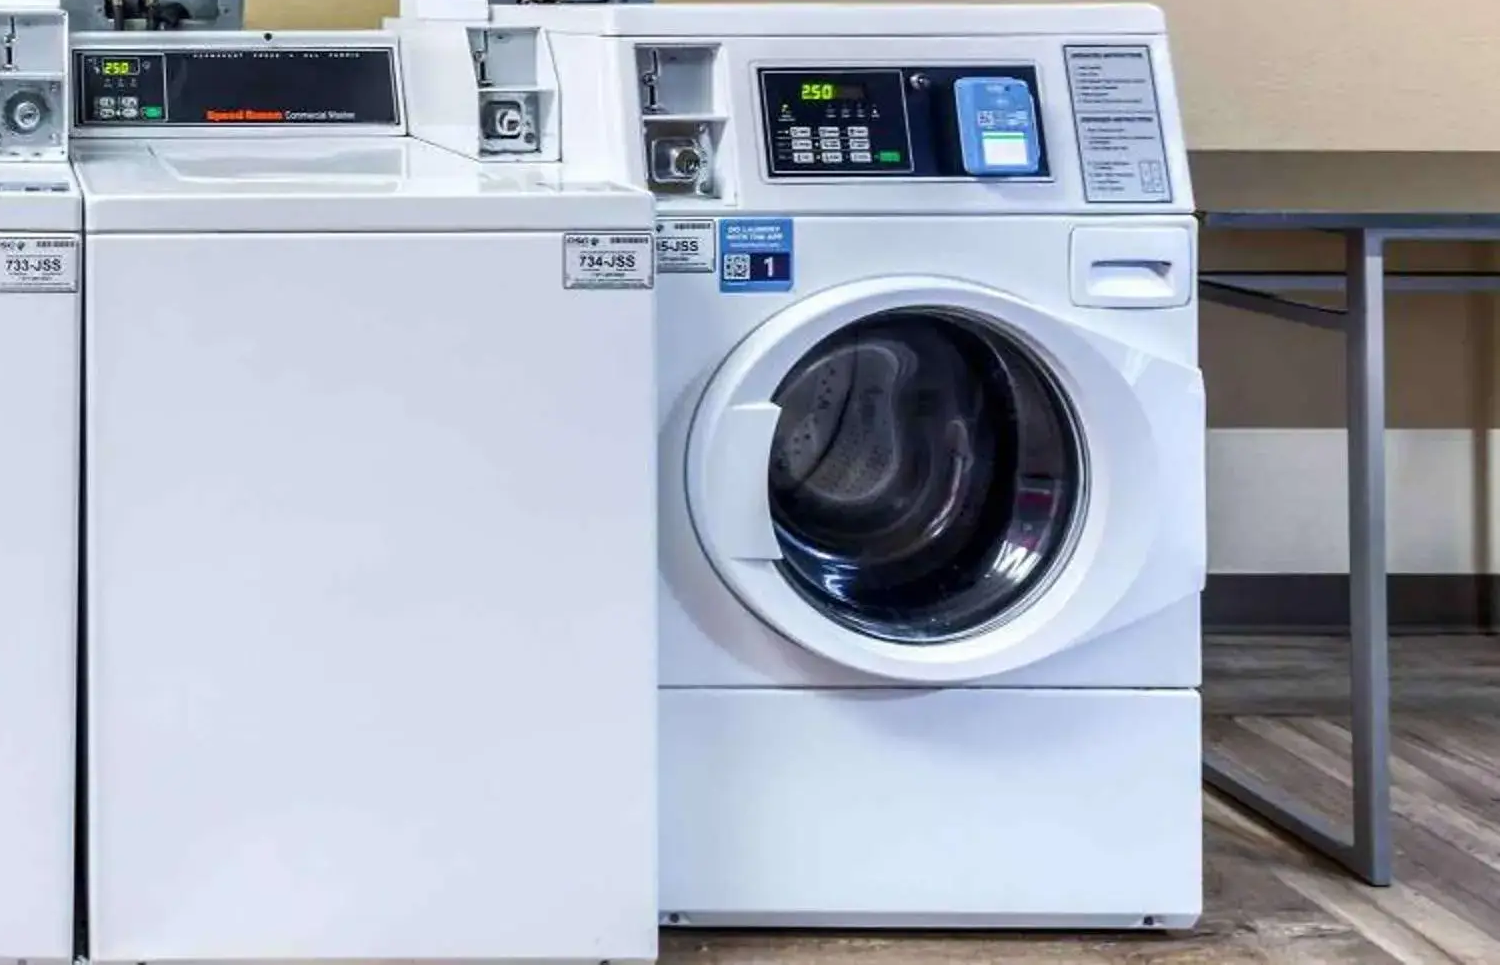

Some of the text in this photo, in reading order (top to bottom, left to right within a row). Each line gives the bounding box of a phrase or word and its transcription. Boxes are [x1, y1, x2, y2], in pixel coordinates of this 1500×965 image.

[5, 258, 62, 272] 733-JSS
[579, 254, 635, 268] 734-JSS
[763, 256, 774, 278] 1
